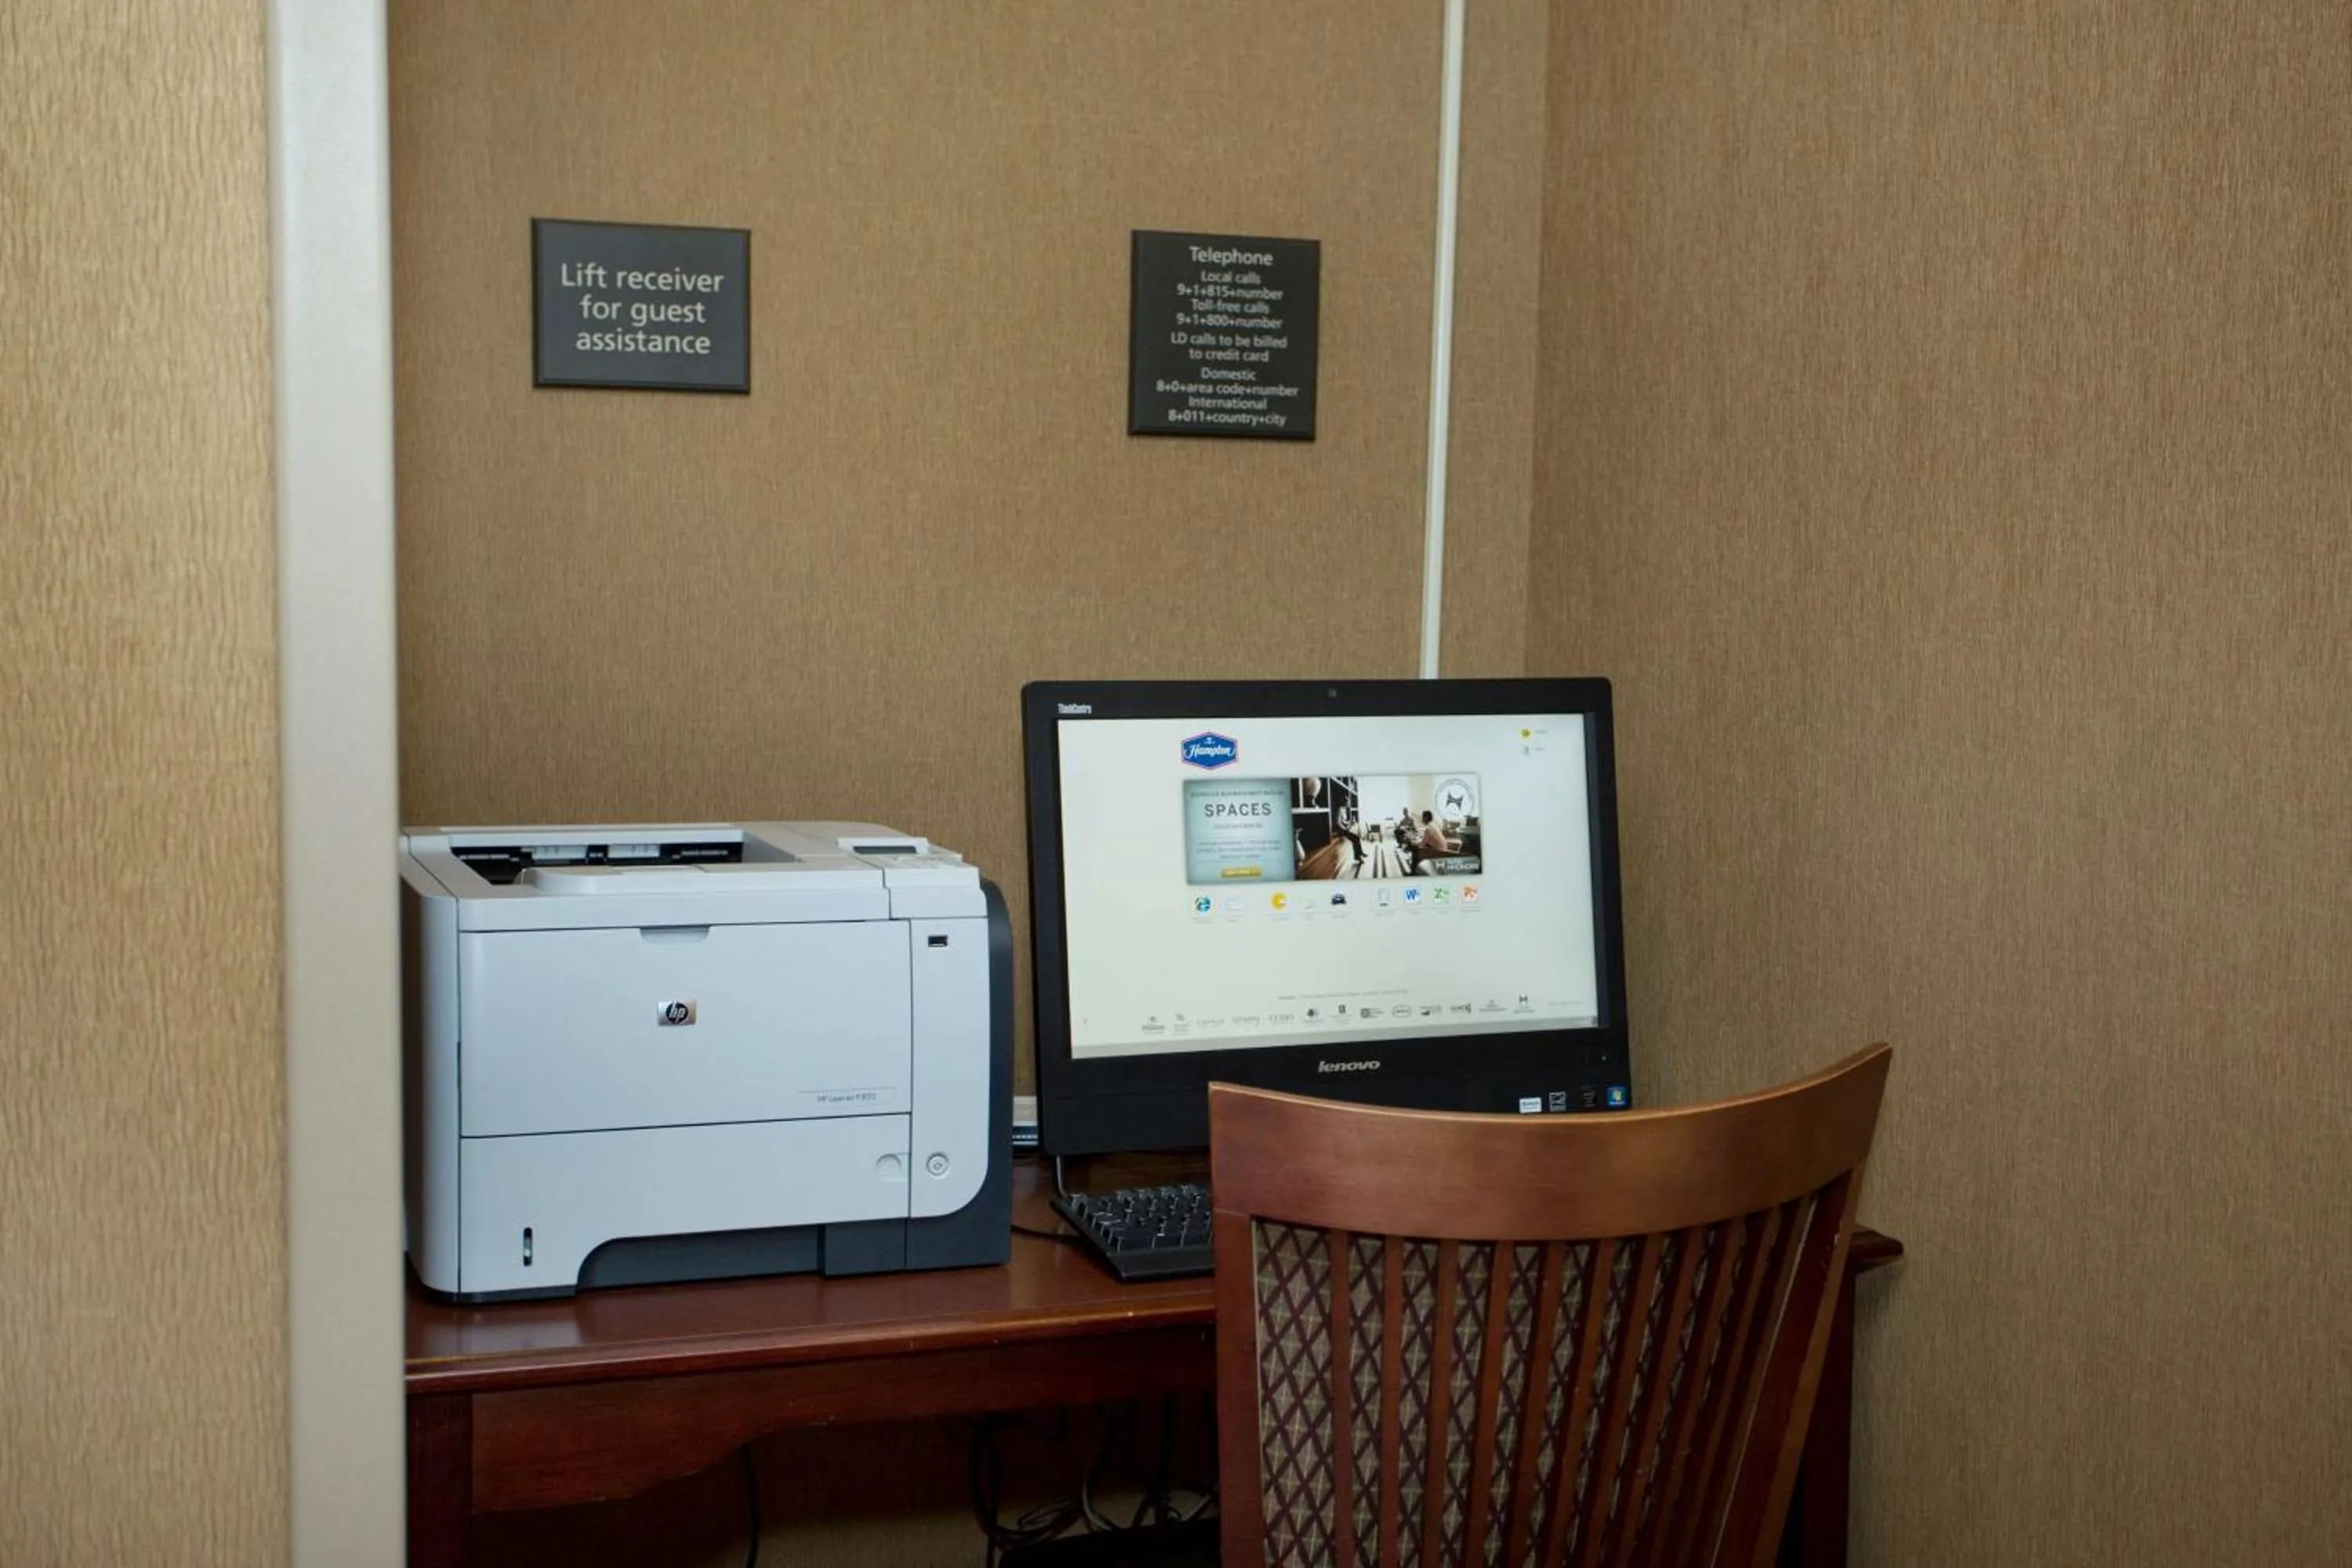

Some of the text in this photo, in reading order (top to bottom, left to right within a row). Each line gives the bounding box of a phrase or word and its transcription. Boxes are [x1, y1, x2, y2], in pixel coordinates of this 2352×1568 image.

[1189, 245, 1274, 267] Telephone
[561, 262, 724, 292] Lift receiver
[1200, 270, 1261, 285] Local calls
[579, 294, 706, 327] for guest
[1243, 301, 1270, 314] calls
[575, 327, 712, 354] assistance
[1171, 332, 1288, 348] LD calls to be billed
[1189, 349, 1269, 362] to credit card
[1200, 367, 1257, 381] Domestic
[1189, 397, 1268, 409] International
[1203, 802, 1272, 817] SPACES
[669, 999, 687, 1023] hp
[1318, 1060, 1381, 1073] lenovo
